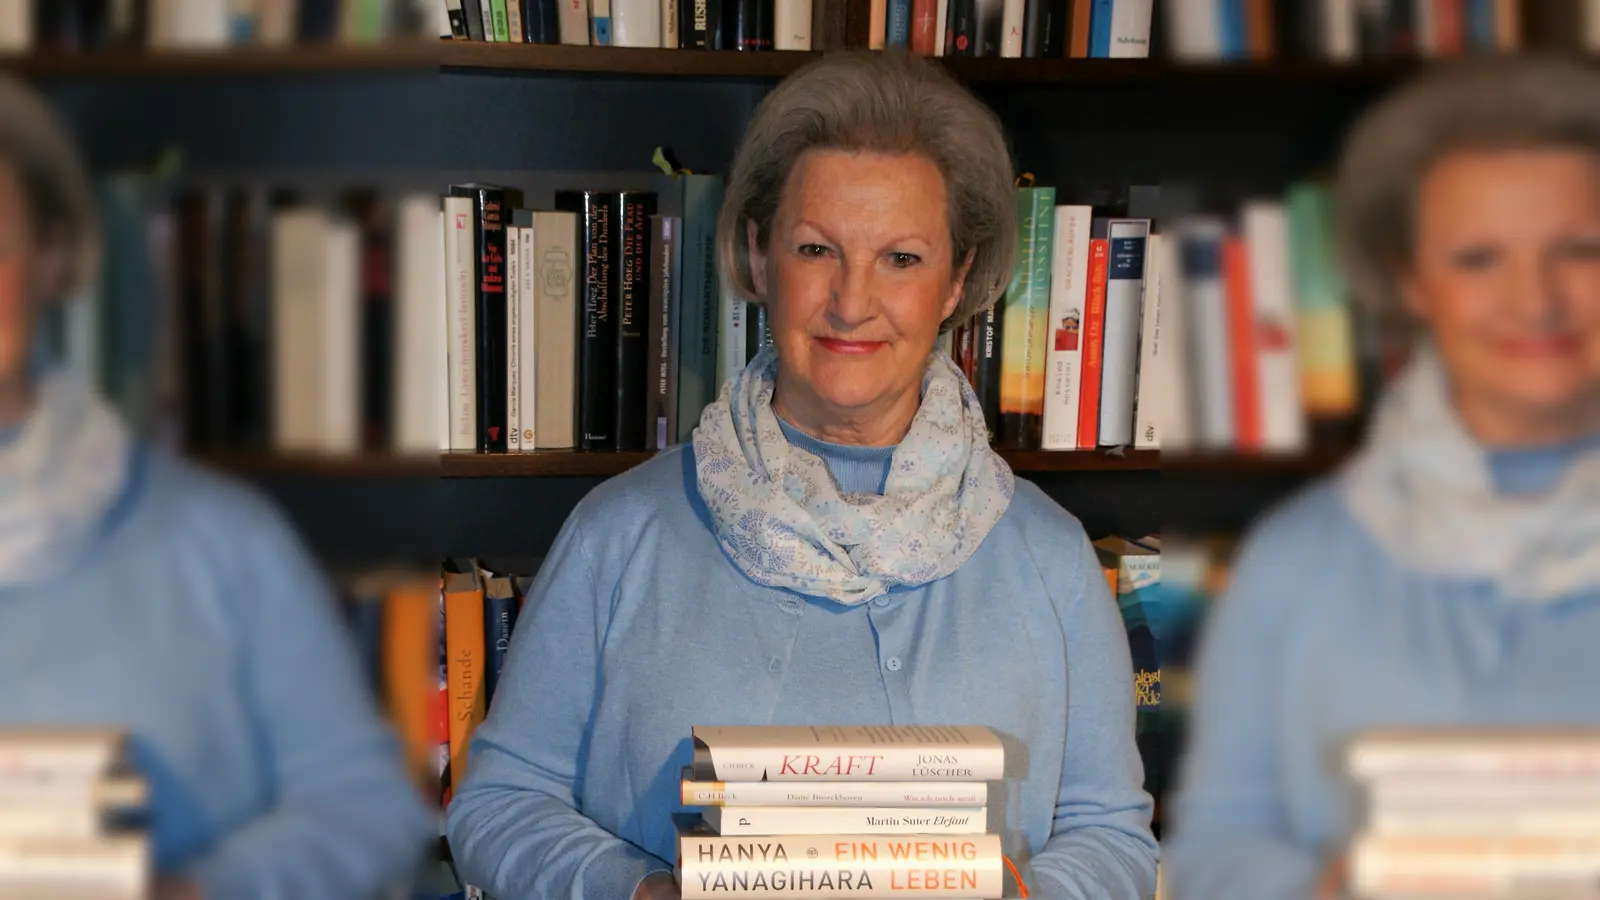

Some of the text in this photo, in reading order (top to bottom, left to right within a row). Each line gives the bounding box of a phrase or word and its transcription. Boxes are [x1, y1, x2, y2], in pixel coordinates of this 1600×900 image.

[589, 204, 598, 220] der
[590, 222, 598, 239] von
[635, 203, 644, 281] UND DER AFFE
[1034, 195, 1051, 300] HOSSEINI
[588, 242, 597, 264] Plan
[597, 204, 609, 322] Abschaffung des Dunkels
[622, 202, 635, 325] PETER HØEG DIE FRAU
[587, 266, 597, 284] Der
[1092, 263, 1103, 283] Box
[1090, 285, 1102, 315] Black
[586, 314, 597, 338] Peter
[1089, 320, 1100, 337] Oz
[701, 337, 710, 355] DIE
[985, 325, 994, 358] KRISTOF
[1088, 338, 1098, 368] Amos
[659, 378, 667, 394] PETER
[509, 427, 518, 444] dtv
[1145, 425, 1154, 442] dtv
[455, 649, 474, 721] Schande
[1134, 667, 1161, 684] alast
[778, 754, 884, 776] KRAFT
[916, 754, 958, 766] JONAS
[911, 766, 973, 777] LÜSCHER
[787, 793, 809, 801] Diane
[903, 794, 918, 802] Was
[934, 794, 955, 802] noch
[866, 815, 900, 827] Martin
[902, 815, 931, 827] Suter
[932, 815, 969, 828] Elefant
[698, 841, 978, 863] HANYA EIN WENIG
[698, 868, 978, 892] YANAGIHARA LEBEN
